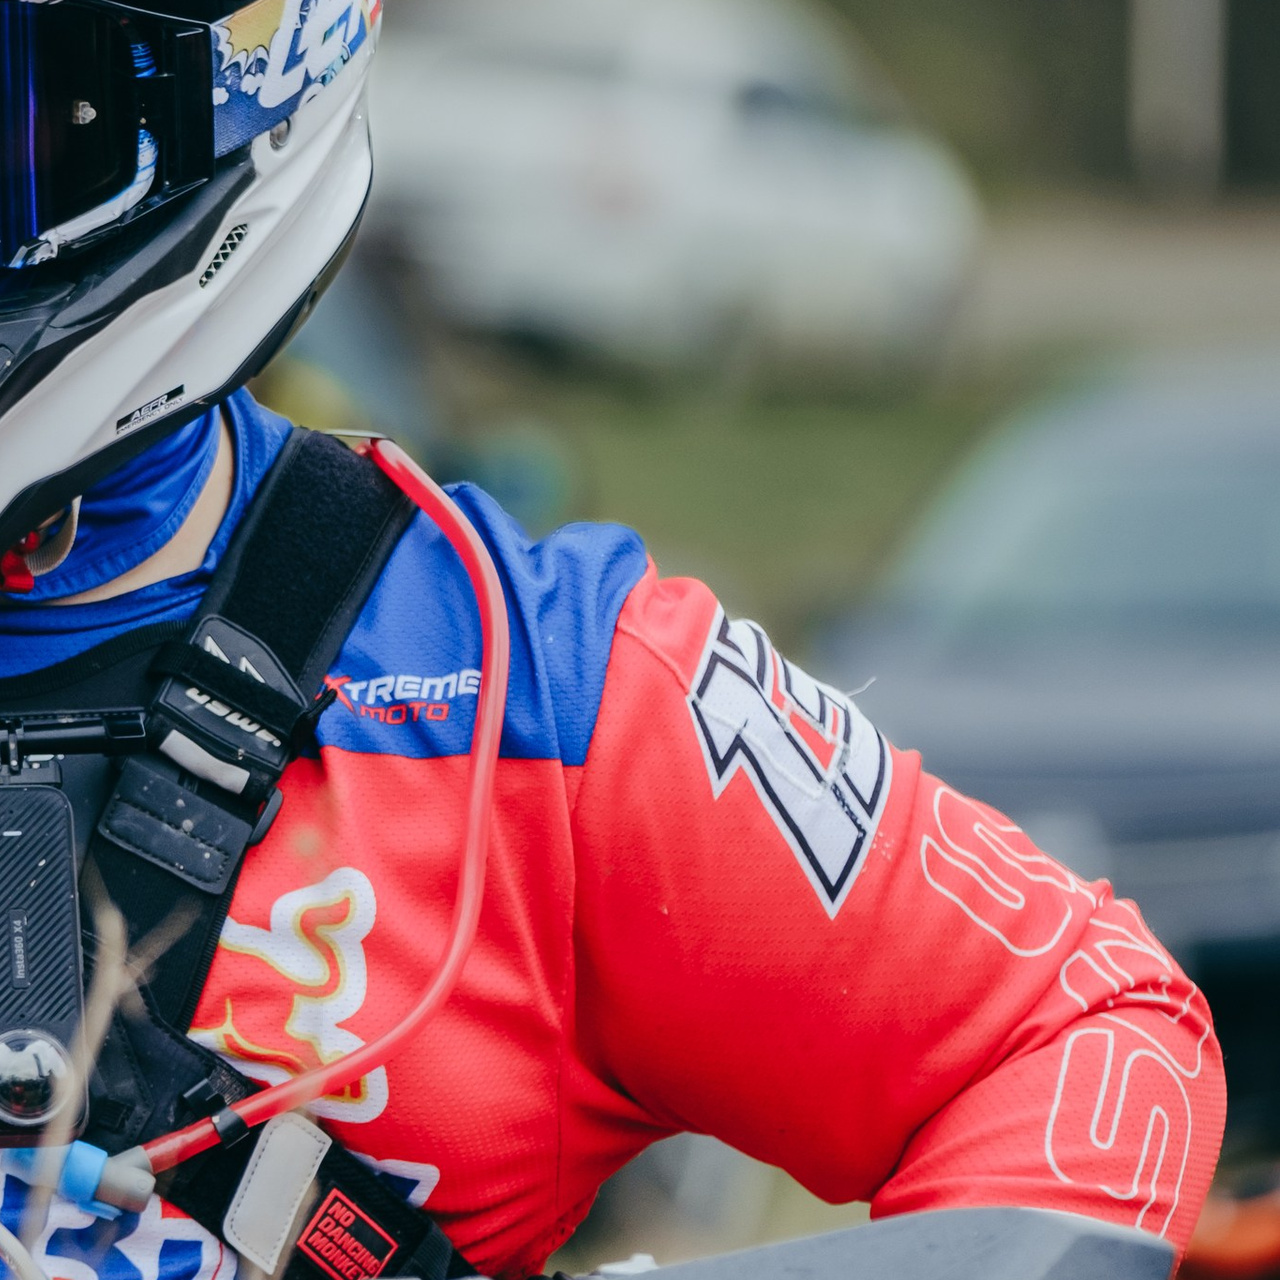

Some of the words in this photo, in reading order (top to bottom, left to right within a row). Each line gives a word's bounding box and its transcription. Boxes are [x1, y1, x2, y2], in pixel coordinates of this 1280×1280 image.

[164, 397, 184, 410] ONLY
[317, 669, 483, 715] XTREME
[360, 701, 450, 725] MOTO
[13, 920, 23, 933] X4
[14, 936, 25, 979] Insta360
[327, 1201, 356, 1228] NO
[318, 1216, 381, 1275] DANCING
